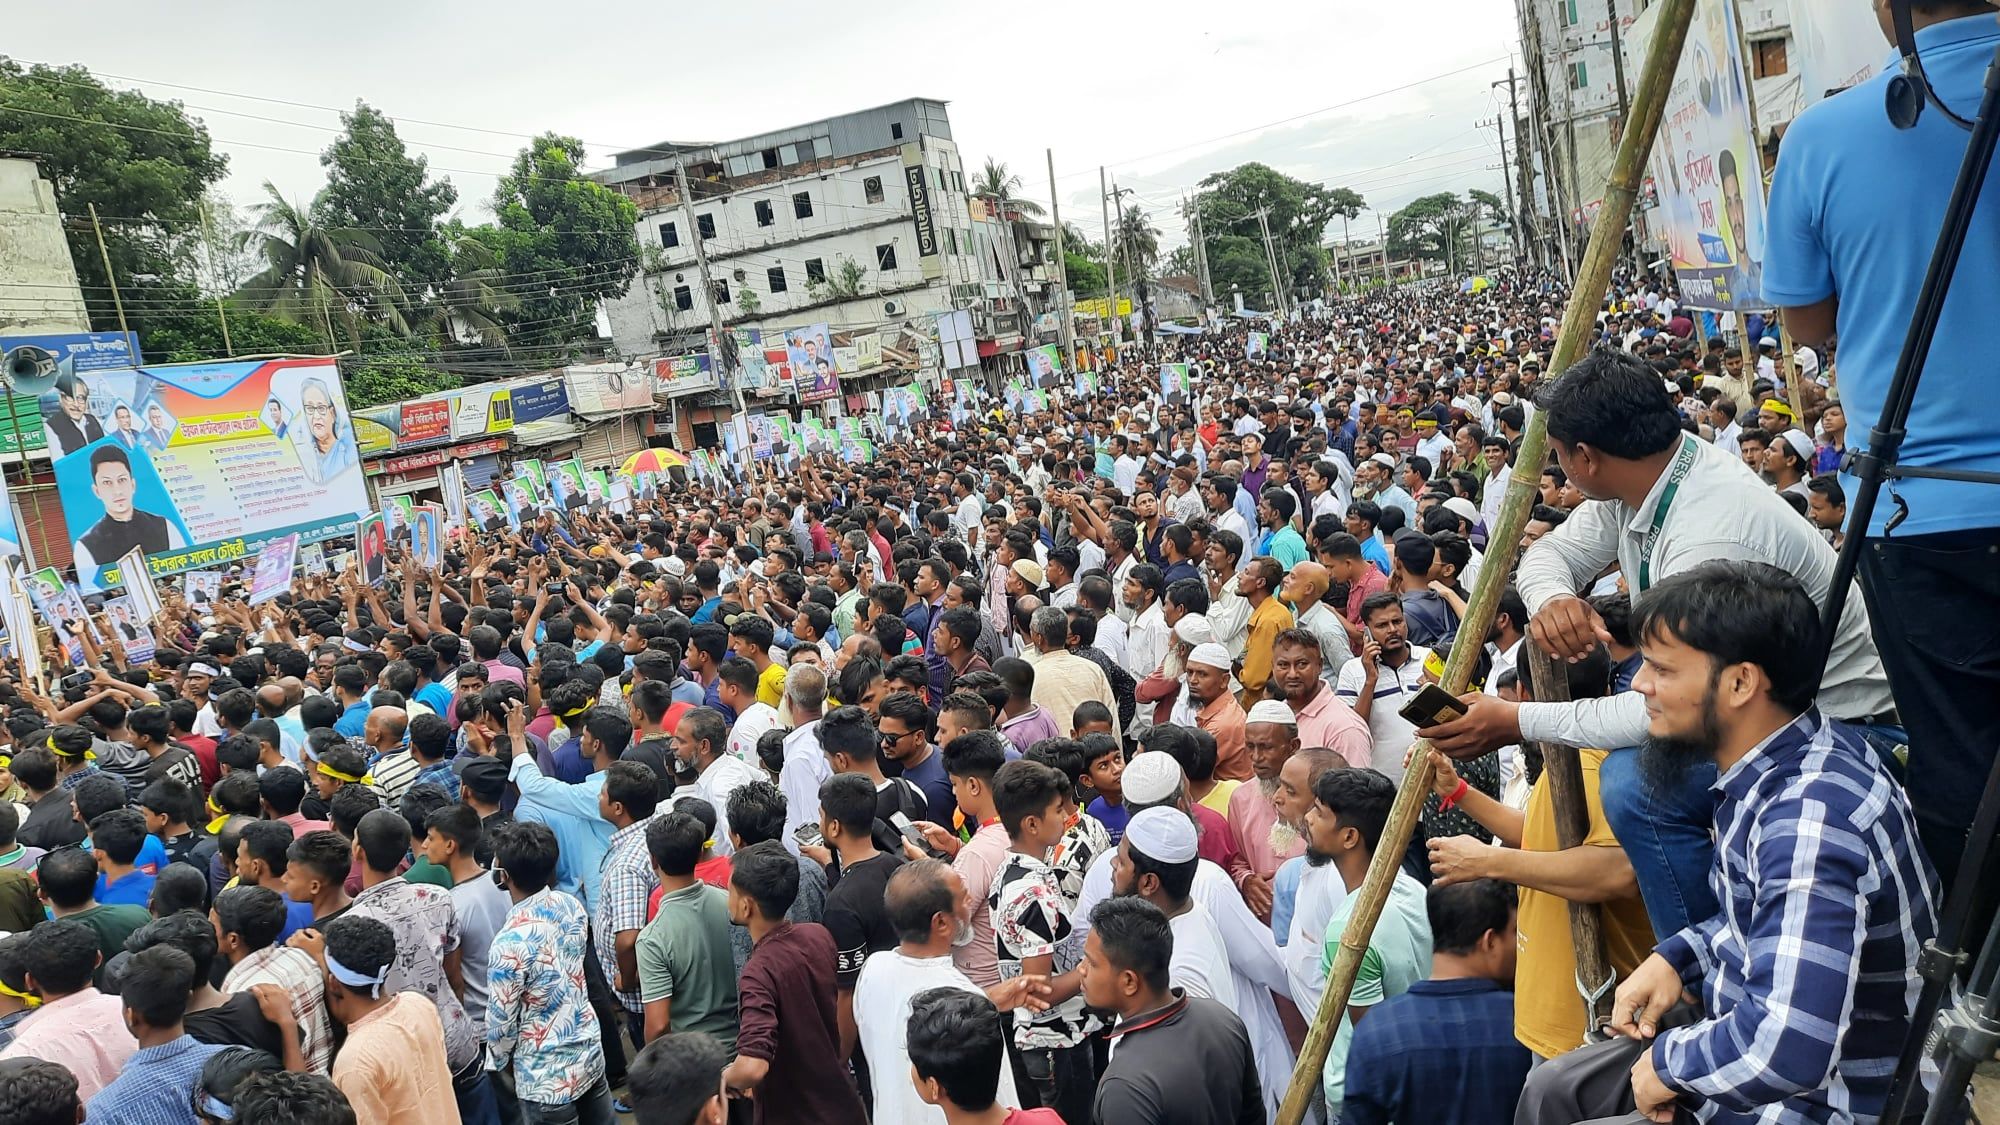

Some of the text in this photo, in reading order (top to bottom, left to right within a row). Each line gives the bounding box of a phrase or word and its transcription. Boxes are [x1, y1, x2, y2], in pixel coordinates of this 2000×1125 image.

[671, 359, 696, 371] BERGER
[1671, 448, 1693, 486] PRESS
[152, 538, 246, 574] ইশরাক সাবাব চৌধুরী
[1642, 525, 1660, 564] PRESS
